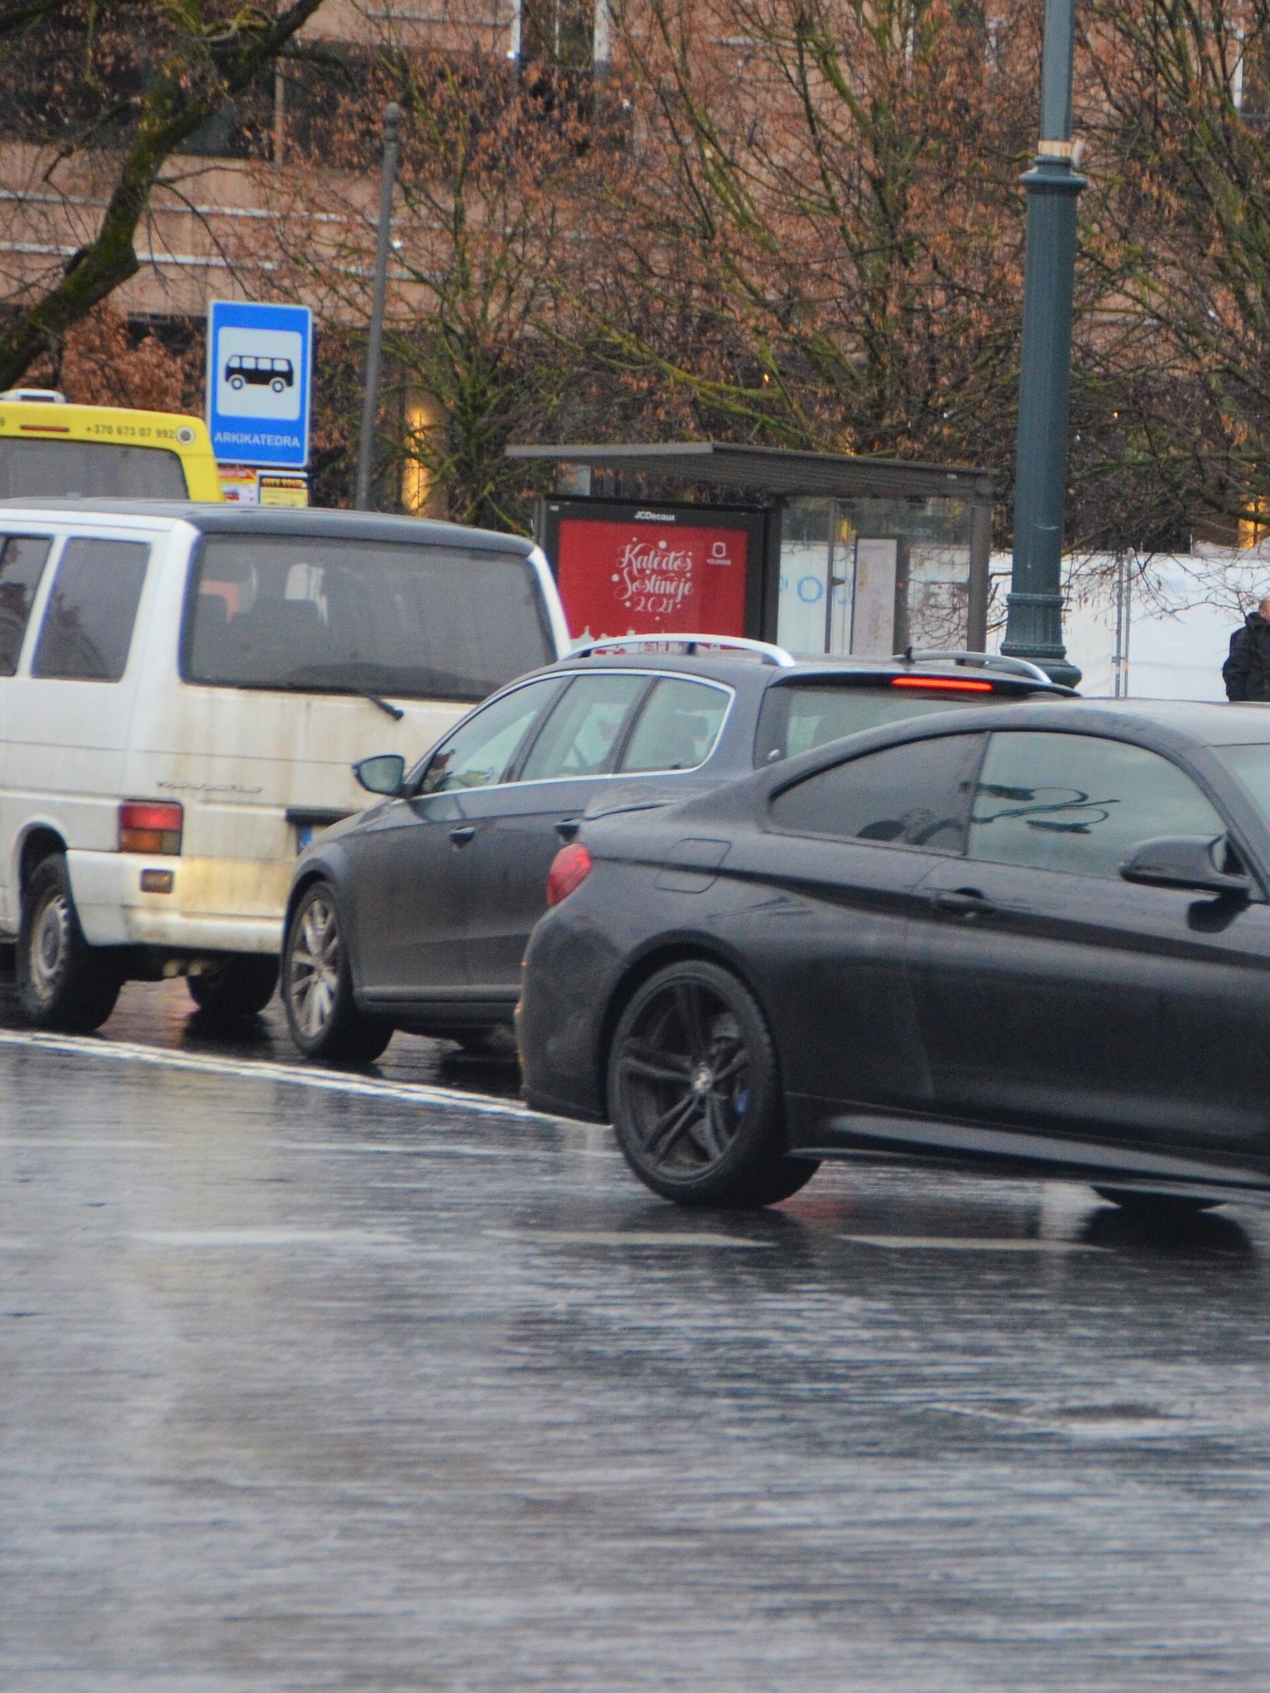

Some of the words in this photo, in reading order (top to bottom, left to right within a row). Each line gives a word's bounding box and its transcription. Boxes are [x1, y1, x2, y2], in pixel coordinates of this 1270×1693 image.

[86, 425, 113, 435] +370
[117, 427, 135, 436] 673
[139, 428, 152, 437] 07
[214, 431, 300, 448] ARKIKATEDRA
[634, 510, 676, 521] JCDecaux
